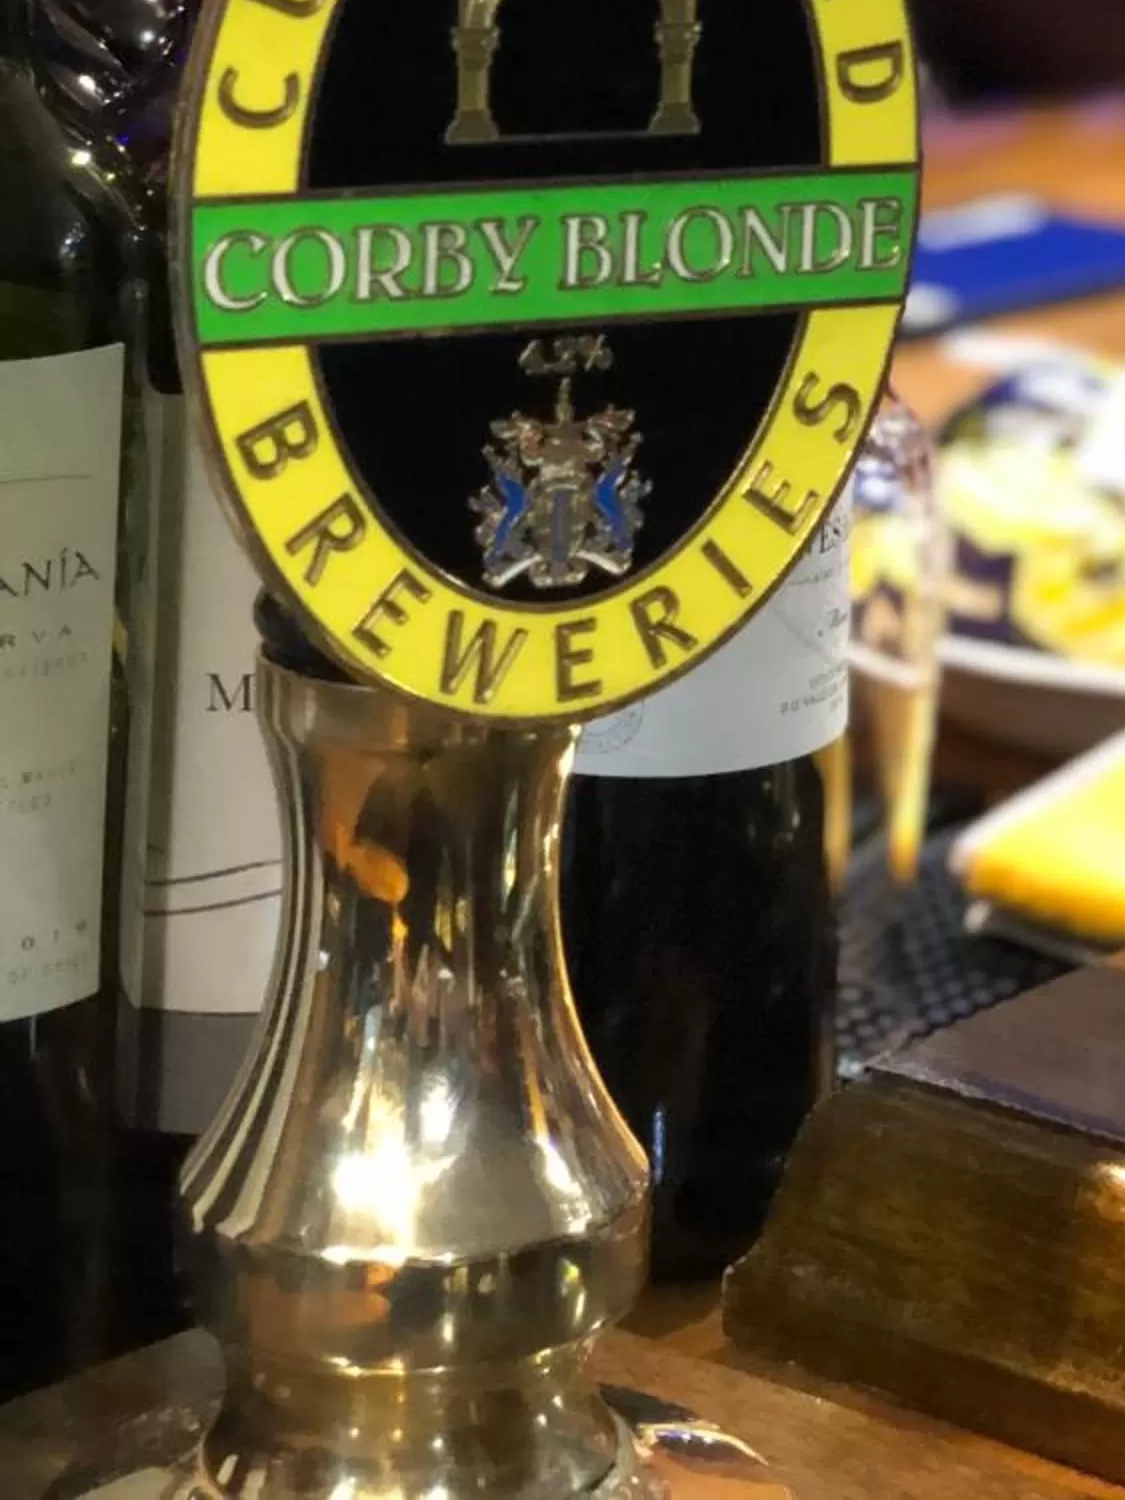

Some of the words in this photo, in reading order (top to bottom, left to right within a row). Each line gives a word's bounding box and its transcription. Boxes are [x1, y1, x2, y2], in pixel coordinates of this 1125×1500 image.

[203, 216, 540, 313] CORBY
[559, 197, 904, 290] BLONDE
[236, 370, 863, 704] BREWERIES
